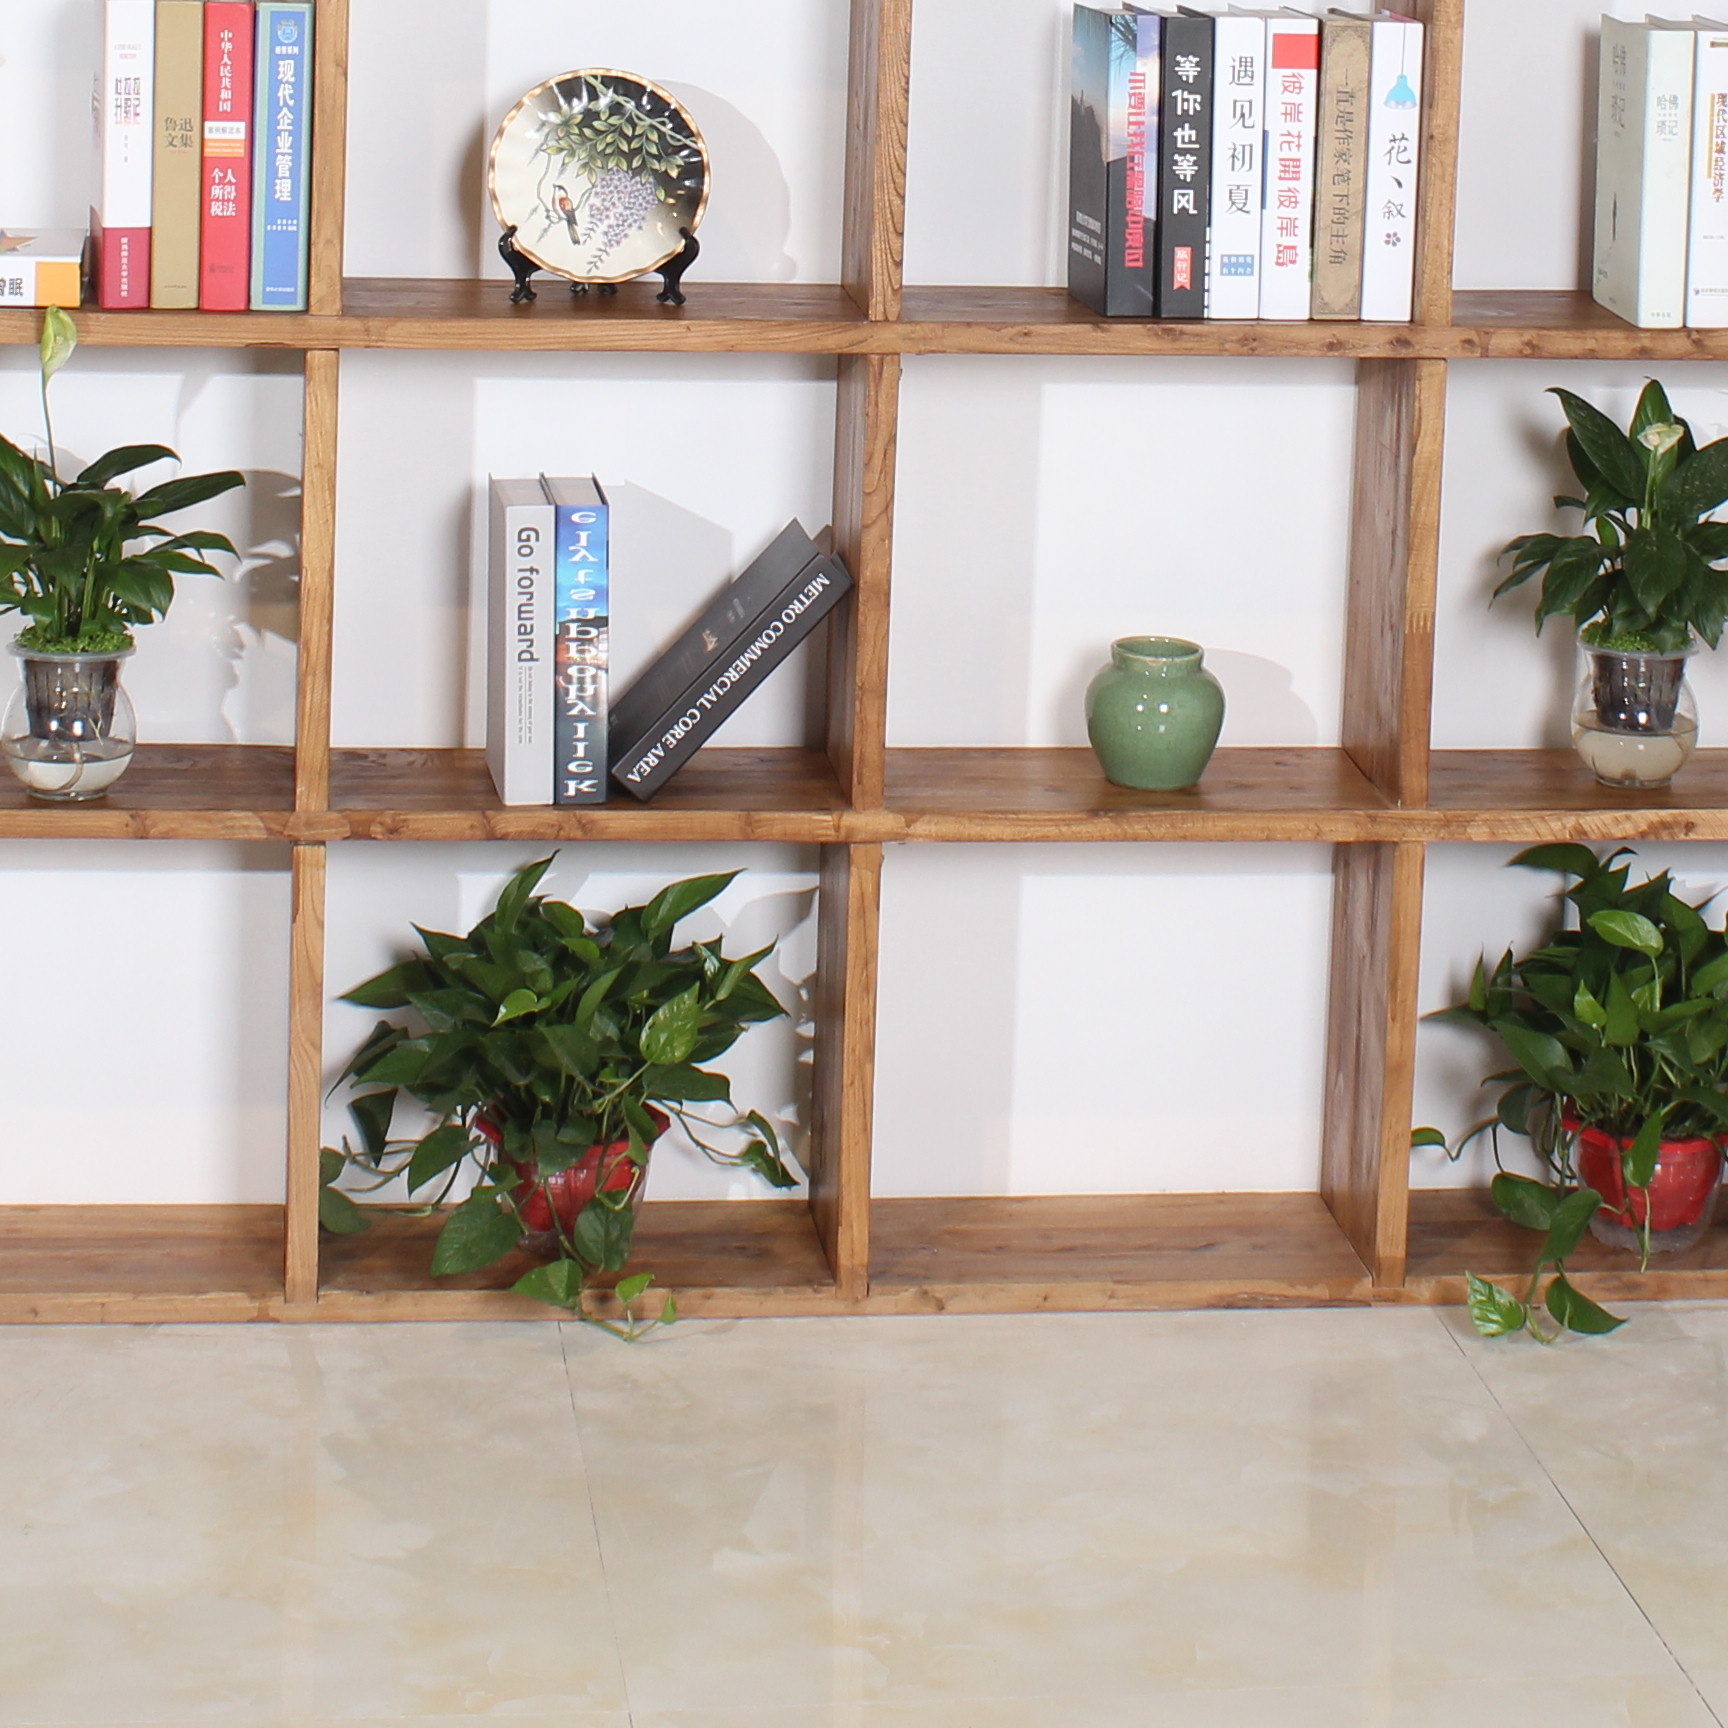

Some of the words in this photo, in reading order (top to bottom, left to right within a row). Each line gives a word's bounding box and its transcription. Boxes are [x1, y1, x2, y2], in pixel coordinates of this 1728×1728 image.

[219, 30, 233, 112] 中华人民共和国
[164, 117, 193, 132] 鲁迅
[1656, 93, 1679, 111] 哈佛
[165, 133, 193, 149] 文集
[274, 59, 296, 202] 现代企业管理
[1172, 54, 1202, 216] 等你也等风
[1225, 55, 1256, 216] 遇见初夏
[1656, 119, 1679, 136] 琐记
[1713, 92, 1728, 203] 现代区域经济学
[211, 167, 236, 183] 个人
[1275, 71, 1305, 267] 彼岸花開彼岸島
[1329, 69, 1355, 265] 一直是作家笔下的主角
[210, 184, 236, 200] 所得
[210, 201, 237, 216] 税法
[517, 527, 540, 558] Go
[516, 566, 540, 663] forward
[781, 572, 831, 624] METRO
[696, 620, 784, 710] COMMERCIAL
[661, 707, 701, 749] CORE
[626, 742, 665, 784] AREA
